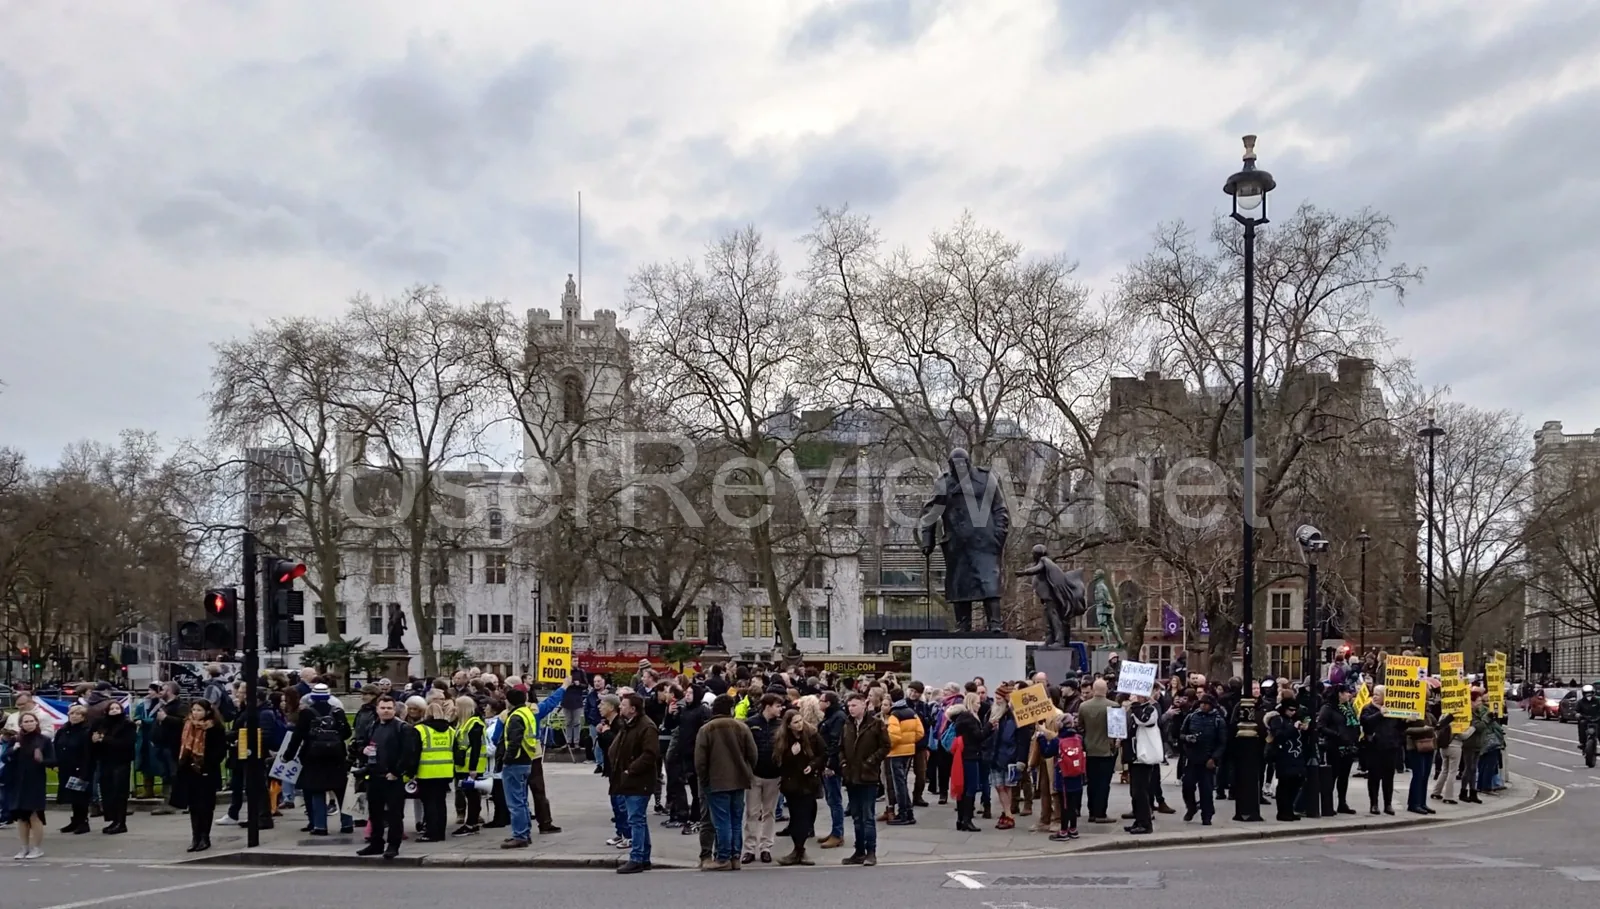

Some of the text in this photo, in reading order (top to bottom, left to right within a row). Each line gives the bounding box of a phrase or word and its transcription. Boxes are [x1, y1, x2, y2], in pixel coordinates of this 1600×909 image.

[548, 636, 564, 645] NO
[541, 645, 570, 654] FARMERS
[915, 645, 1012, 660] CHURCHILL
[547, 658, 563, 666] NO
[824, 662, 876, 671] BIGBUS.COM
[1386, 656, 1421, 667] NetZero
[542, 667, 567, 679] FOOD
[1386, 667, 1408, 677] aims
[1385, 679, 1420, 688] to make
[1385, 688, 1420, 700] farmers
[1025, 700, 1051, 712] FARMERS
[1385, 700, 1417, 710] extinct.
[1017, 705, 1053, 722] NO FOOD
